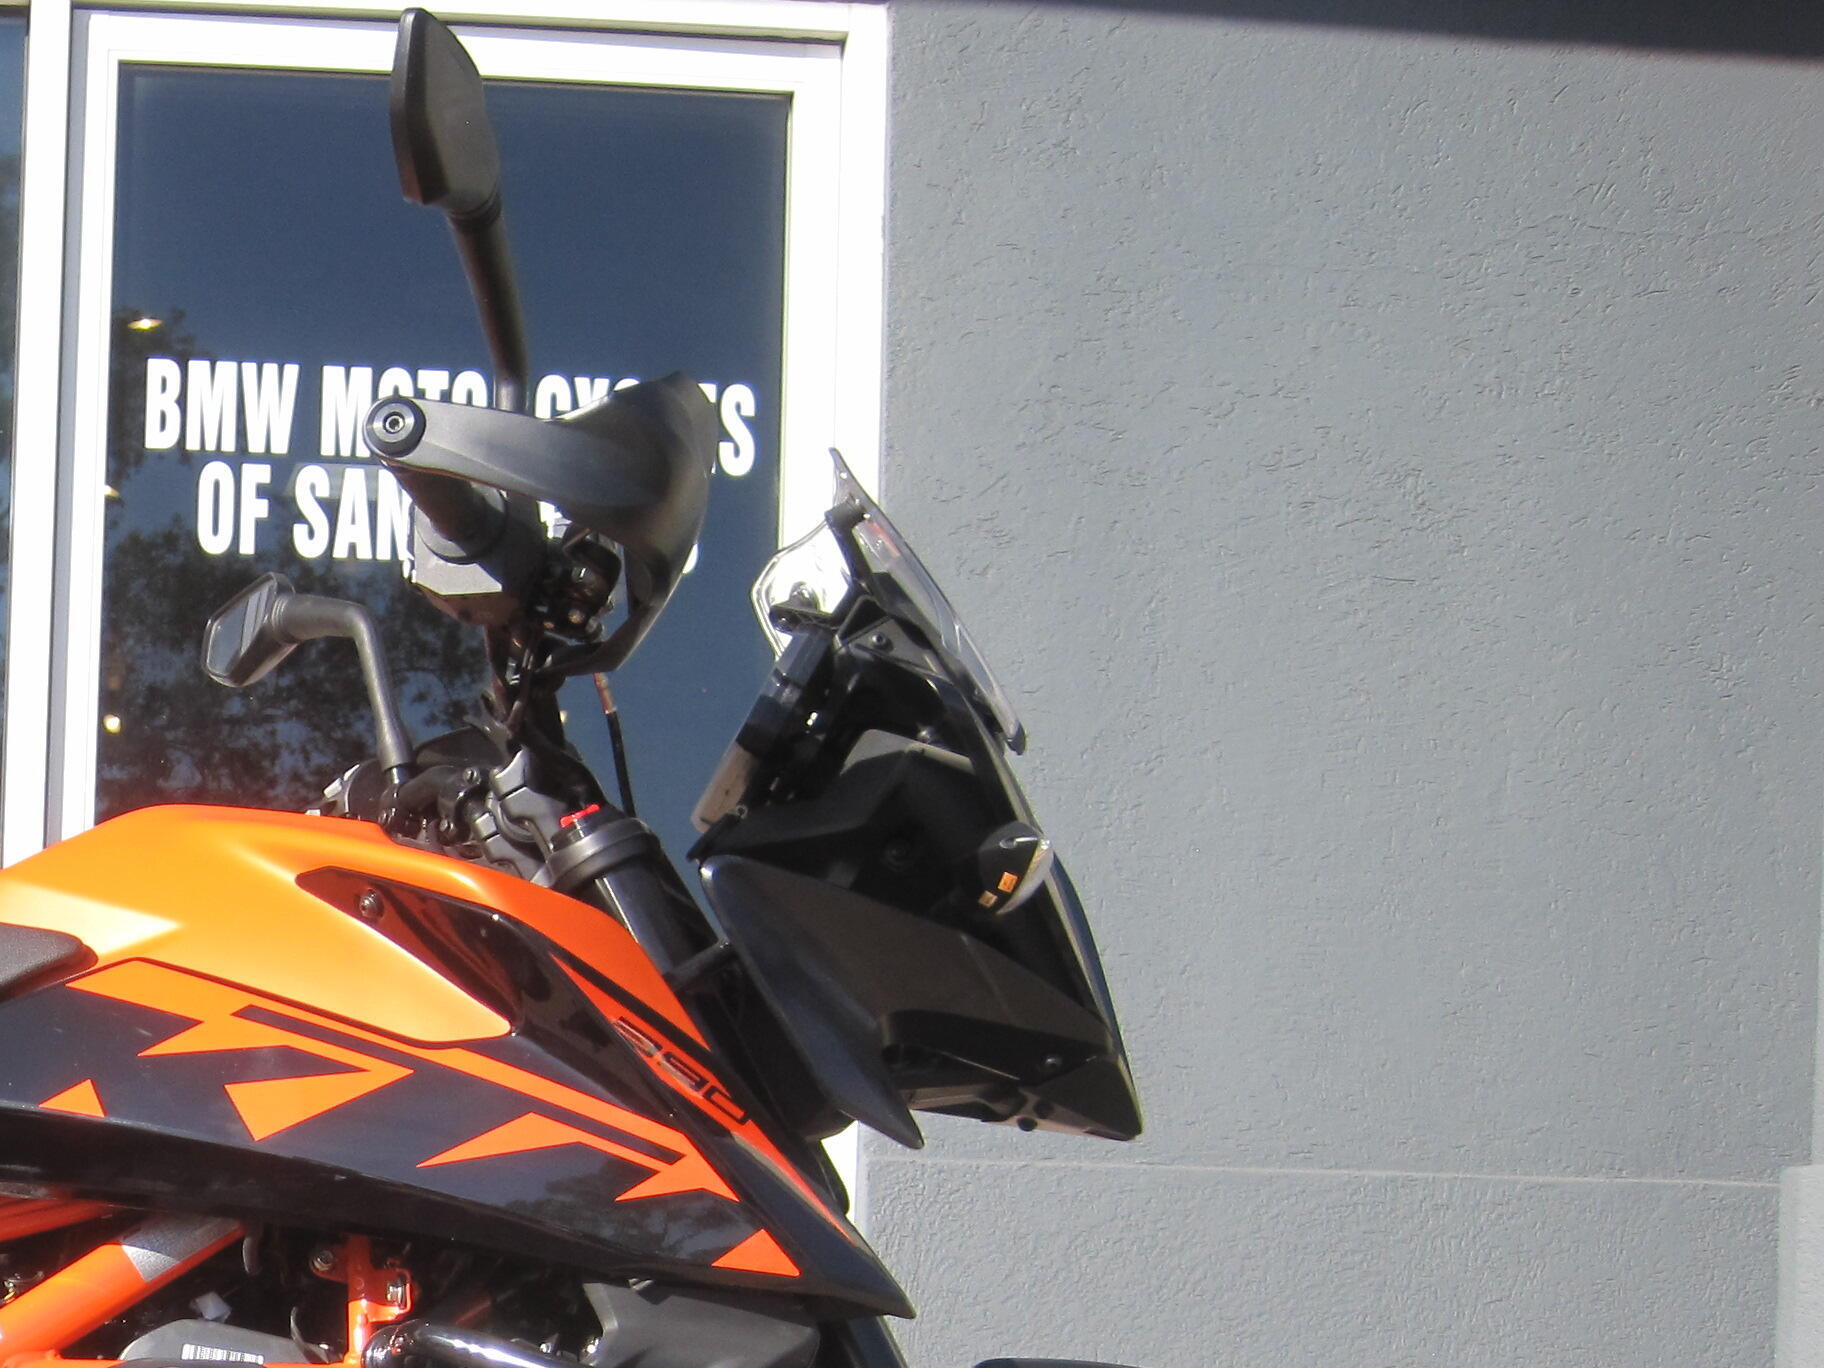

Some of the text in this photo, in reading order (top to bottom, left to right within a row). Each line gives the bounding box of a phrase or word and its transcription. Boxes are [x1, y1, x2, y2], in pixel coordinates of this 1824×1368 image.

[143, 357, 300, 455] BMW
[196, 459, 414, 563] OF SAN
